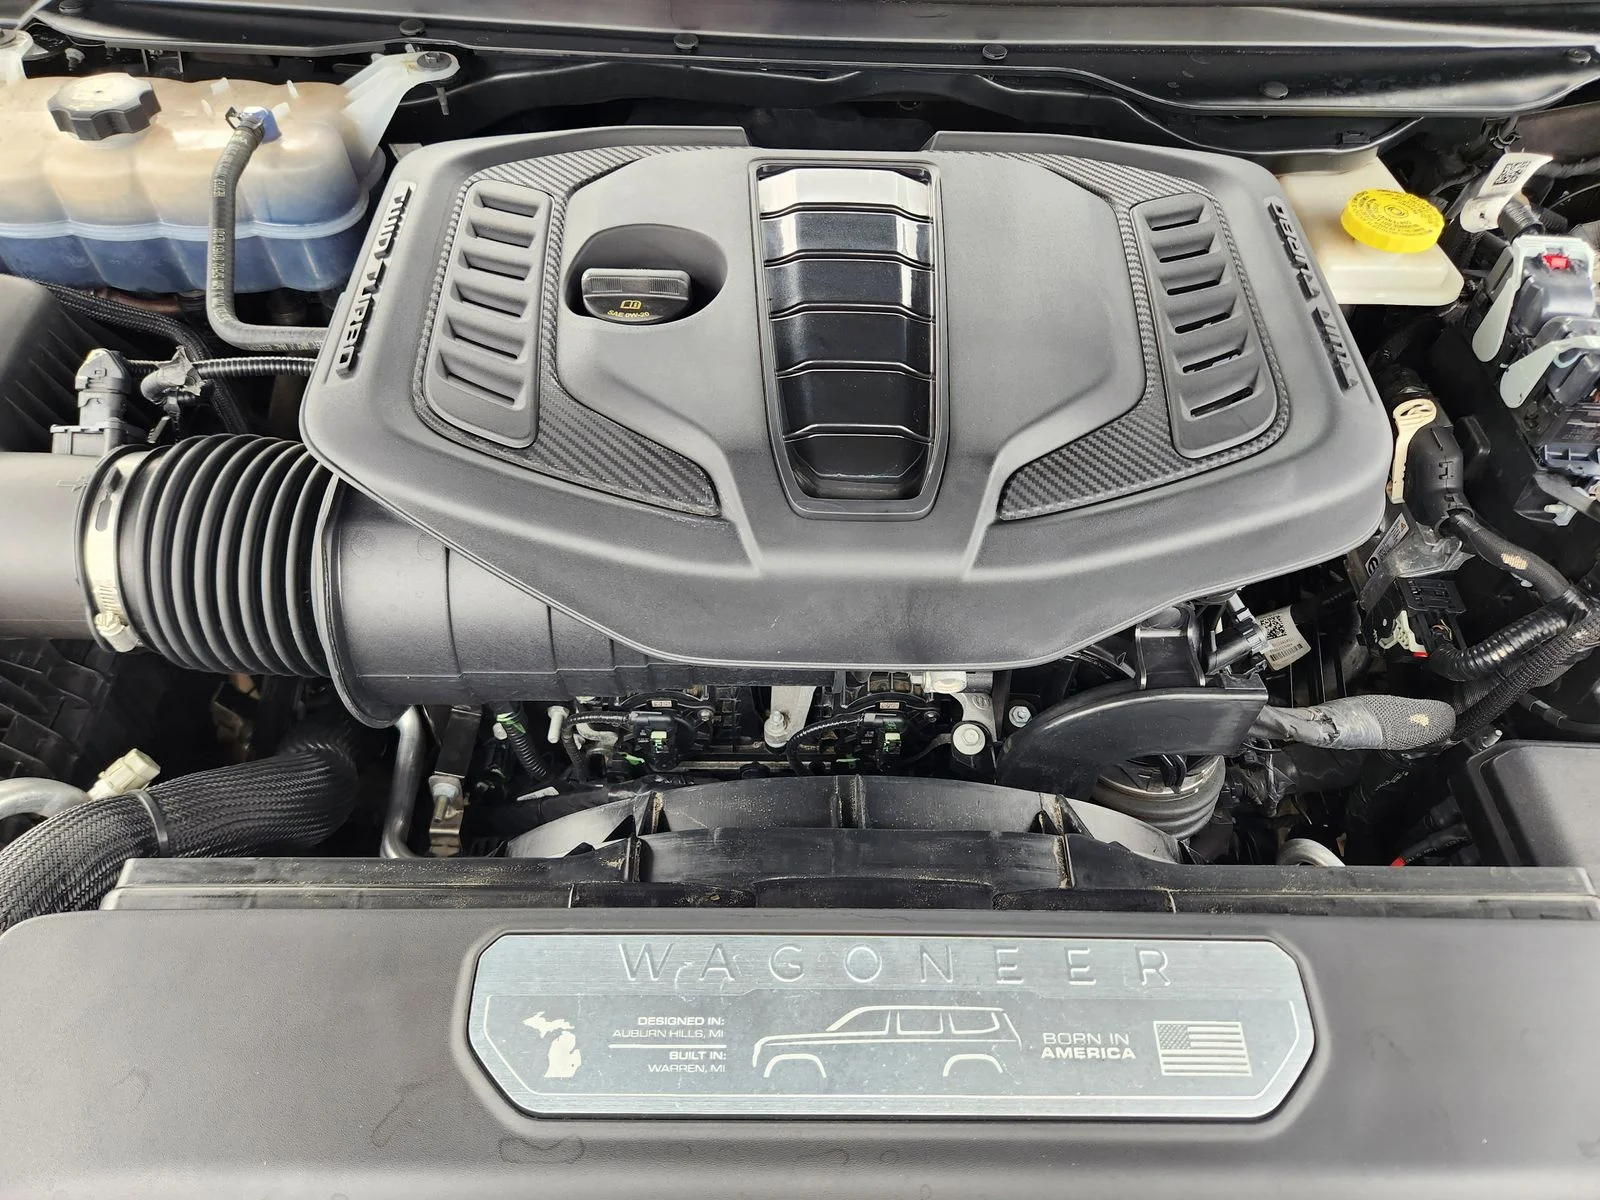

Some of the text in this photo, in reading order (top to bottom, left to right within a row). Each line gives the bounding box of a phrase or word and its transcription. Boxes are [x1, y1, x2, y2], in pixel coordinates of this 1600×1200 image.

[1268, 202, 1321, 301] TURBO
[607, 309, 624, 317] SAE
[335, 261, 387, 379] TURBO
[618, 942, 1171, 986] WAGONEER
[637, 1016, 725, 1026] DESIGNED IN:
[612, 1029, 724, 1039] AUBURN HILLS, MI
[1042, 1032, 1131, 1046] BORN IN
[669, 1051, 727, 1060] BUILT IN:
[1041, 1046, 1137, 1060] AMERICA
[648, 1064, 726, 1074] WARREN, MI
